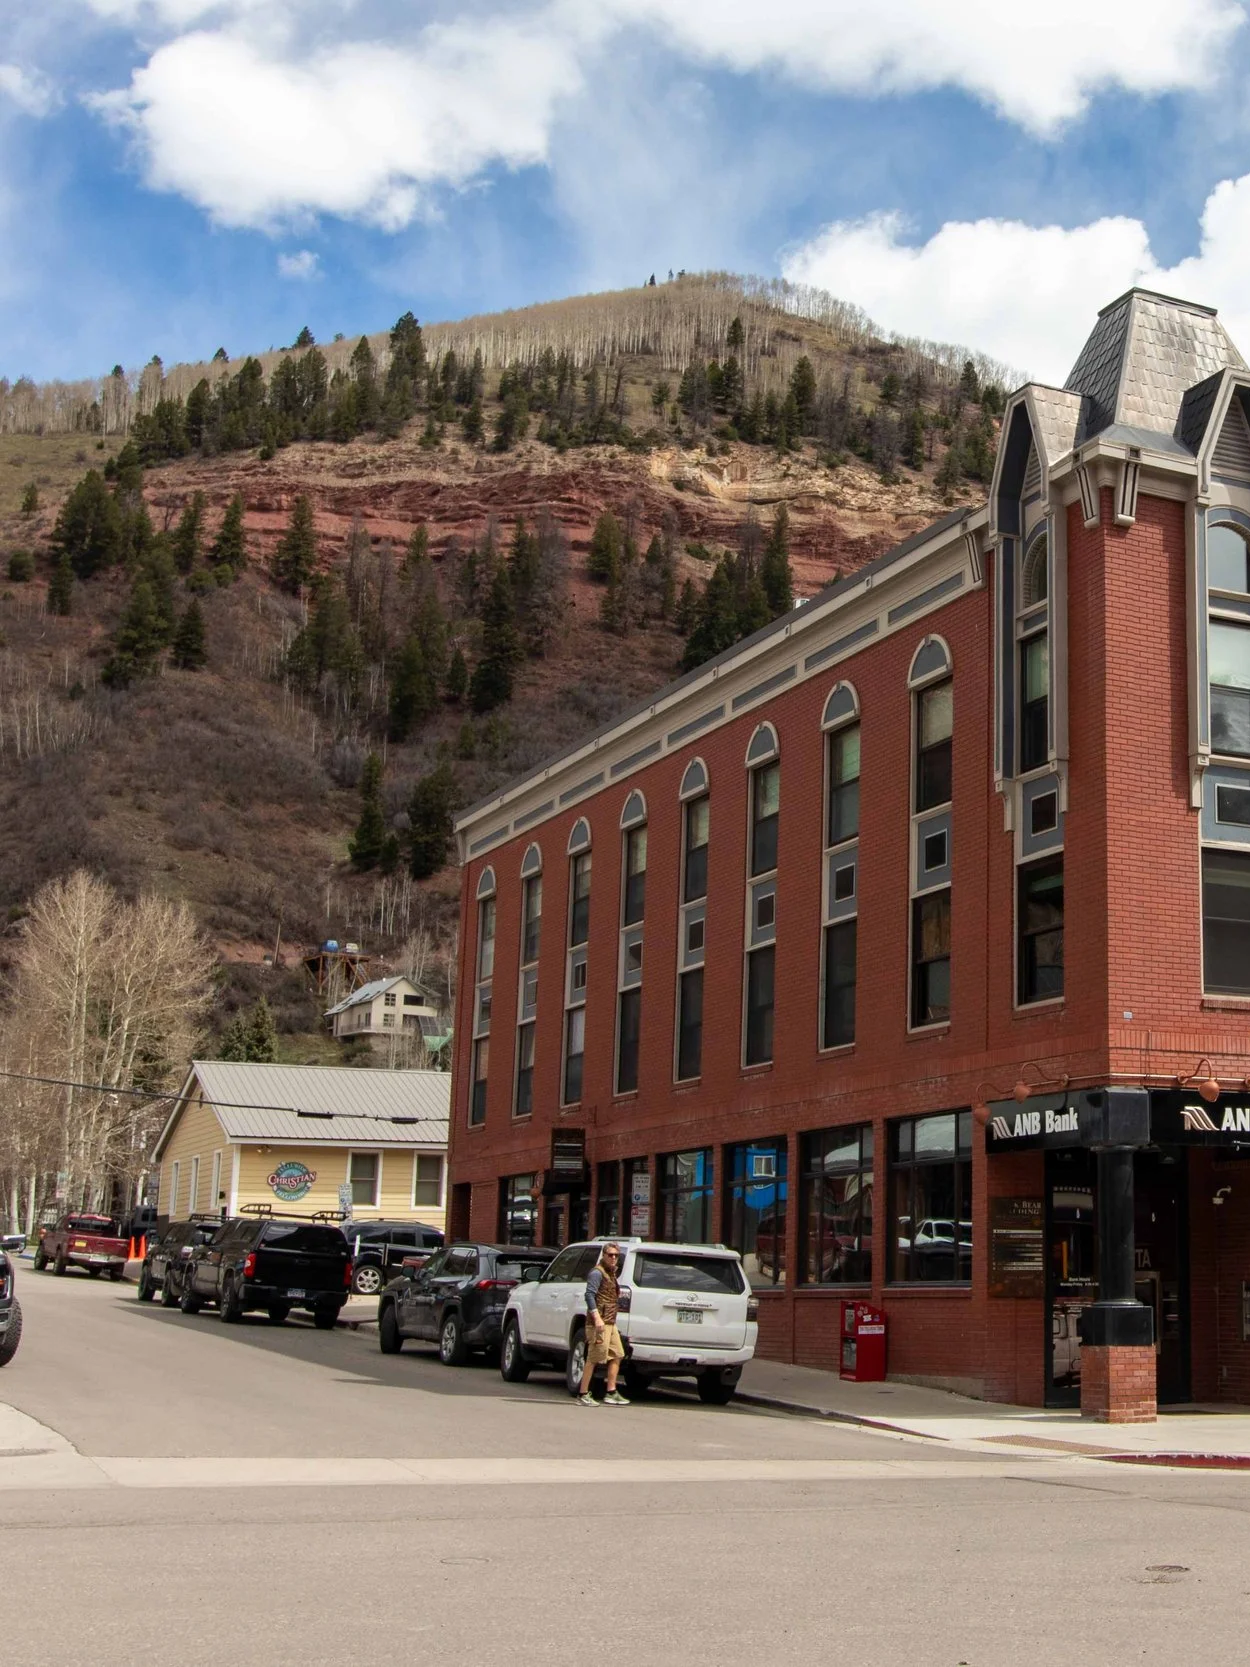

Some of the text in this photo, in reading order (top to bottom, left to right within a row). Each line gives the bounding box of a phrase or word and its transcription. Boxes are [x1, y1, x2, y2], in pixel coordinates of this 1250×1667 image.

[1013, 1107, 1078, 1137] ANB Bank
[268, 1172, 316, 1189] CHRISTIAN
